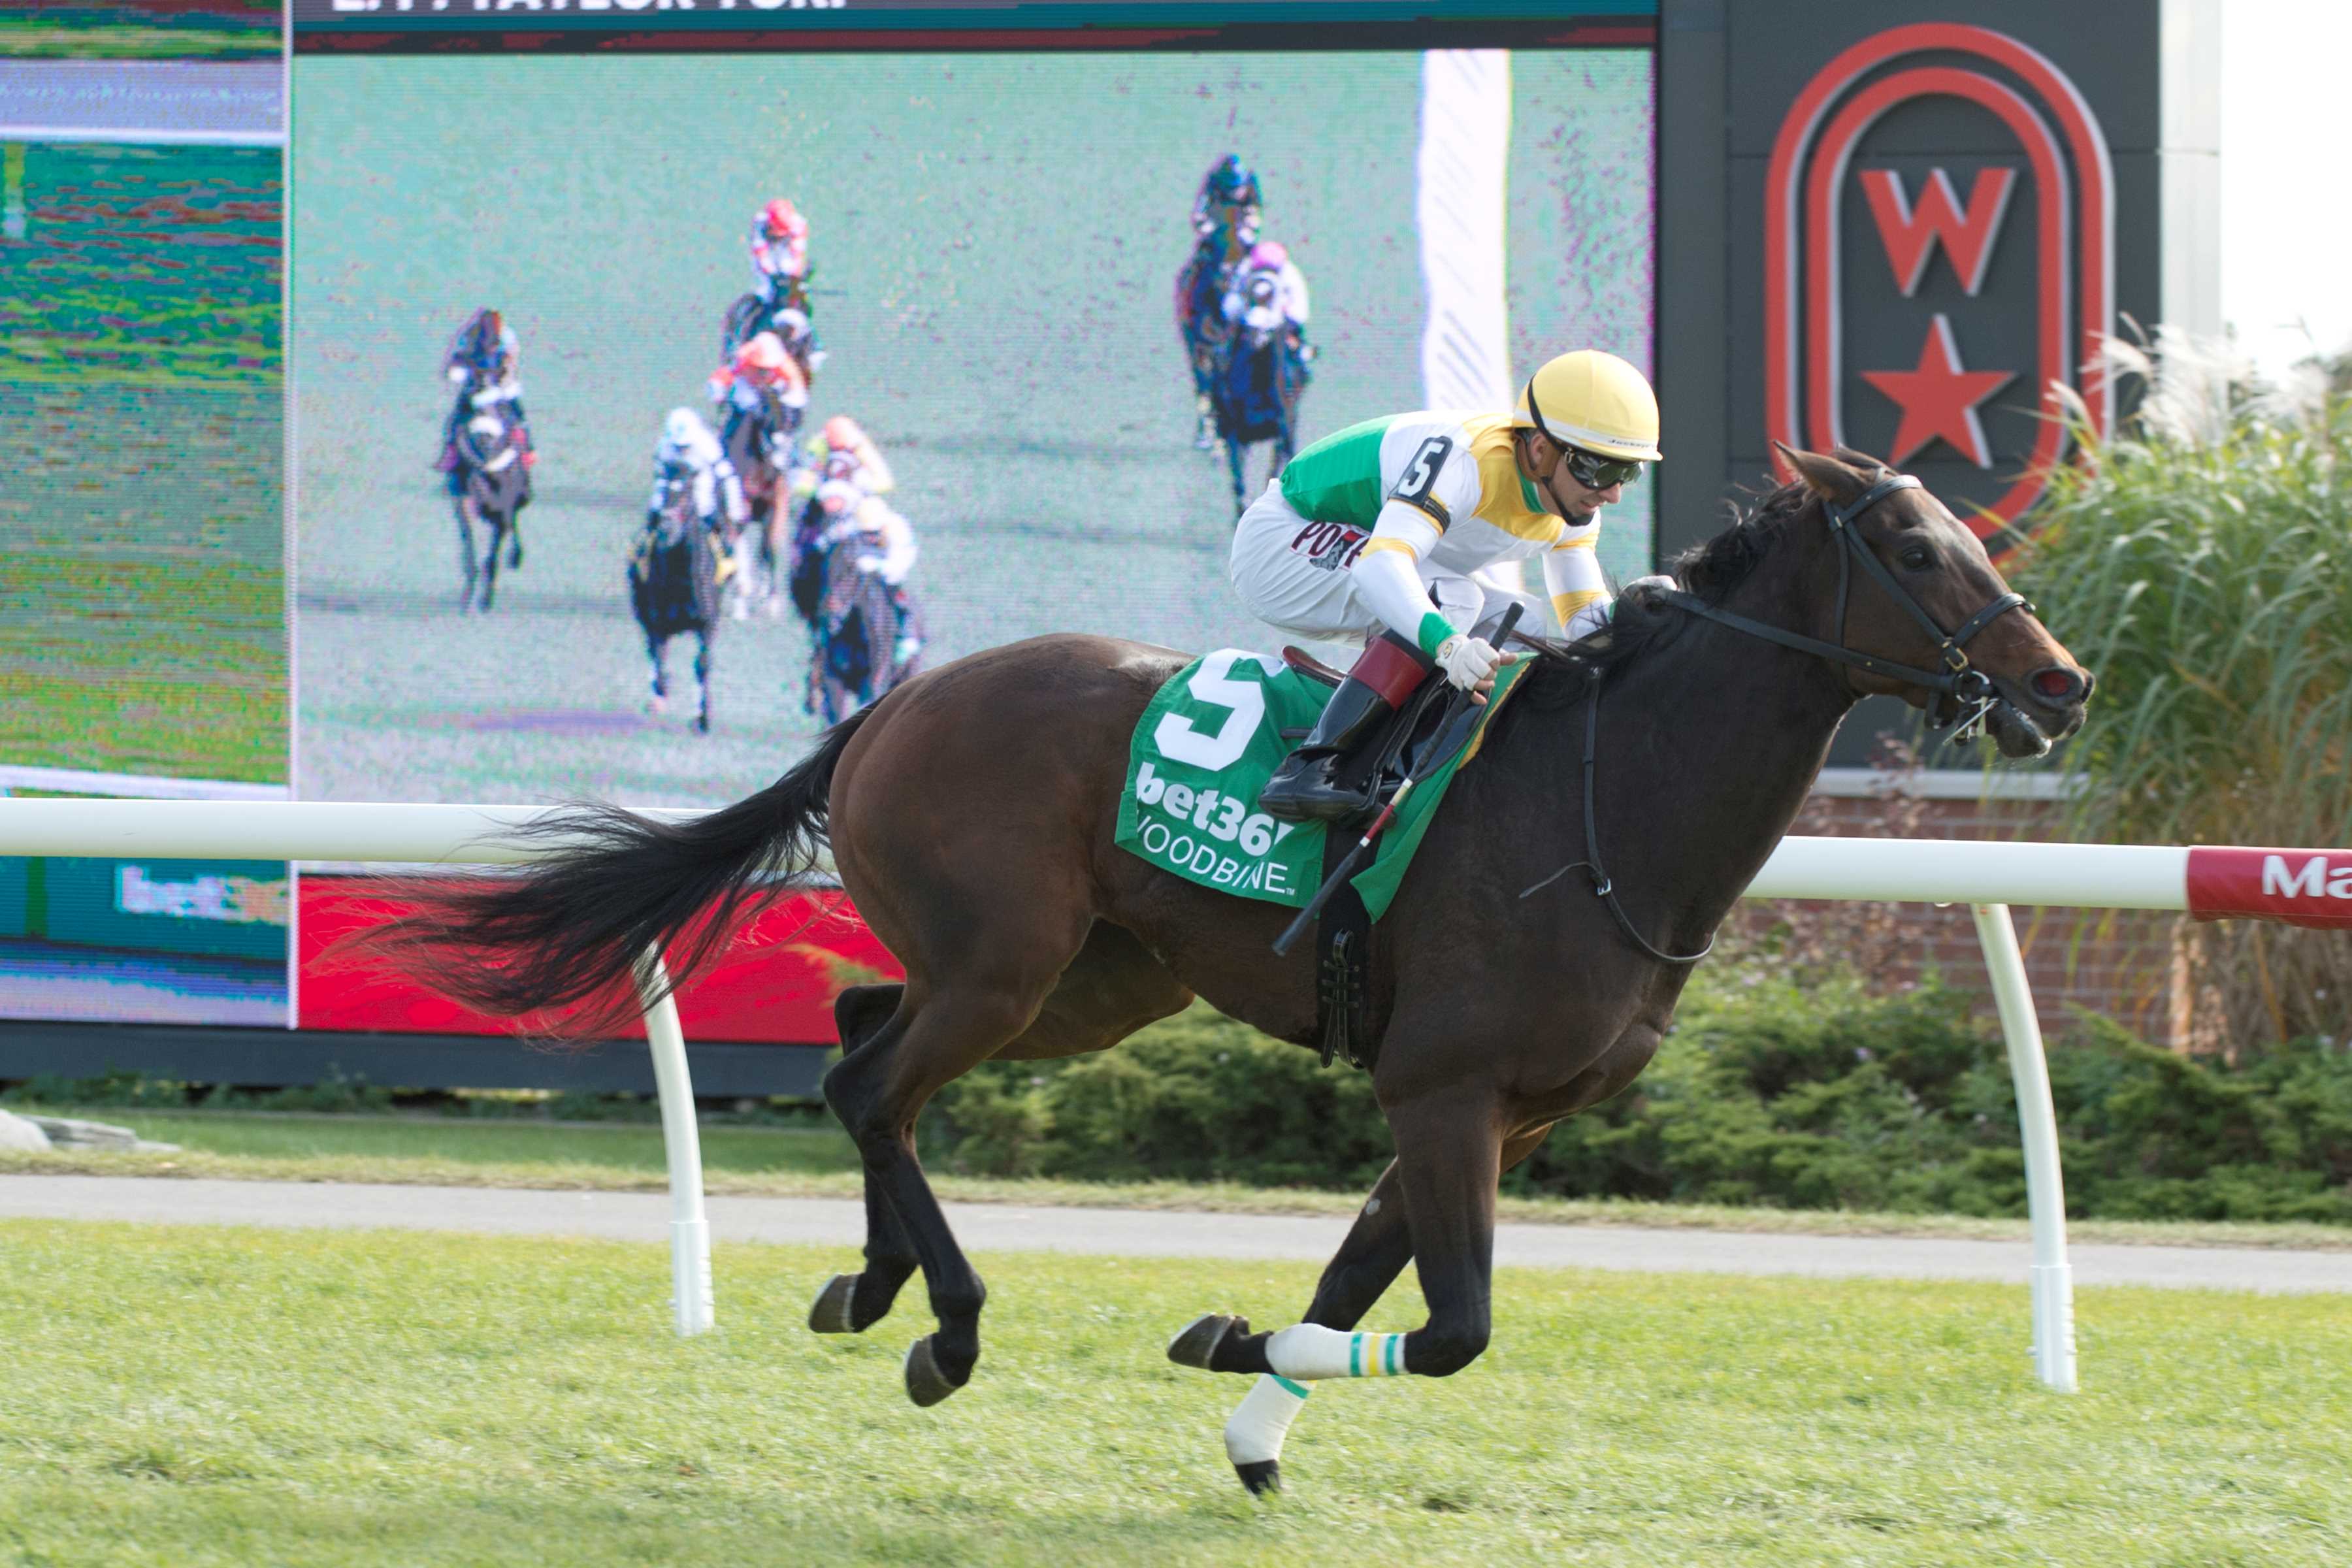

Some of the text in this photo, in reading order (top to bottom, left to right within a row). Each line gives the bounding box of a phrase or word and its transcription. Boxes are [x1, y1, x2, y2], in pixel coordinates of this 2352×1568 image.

[1858, 167, 2016, 297] W
[1398, 442, 1445, 497] 5
[1154, 648, 1292, 772] 5
